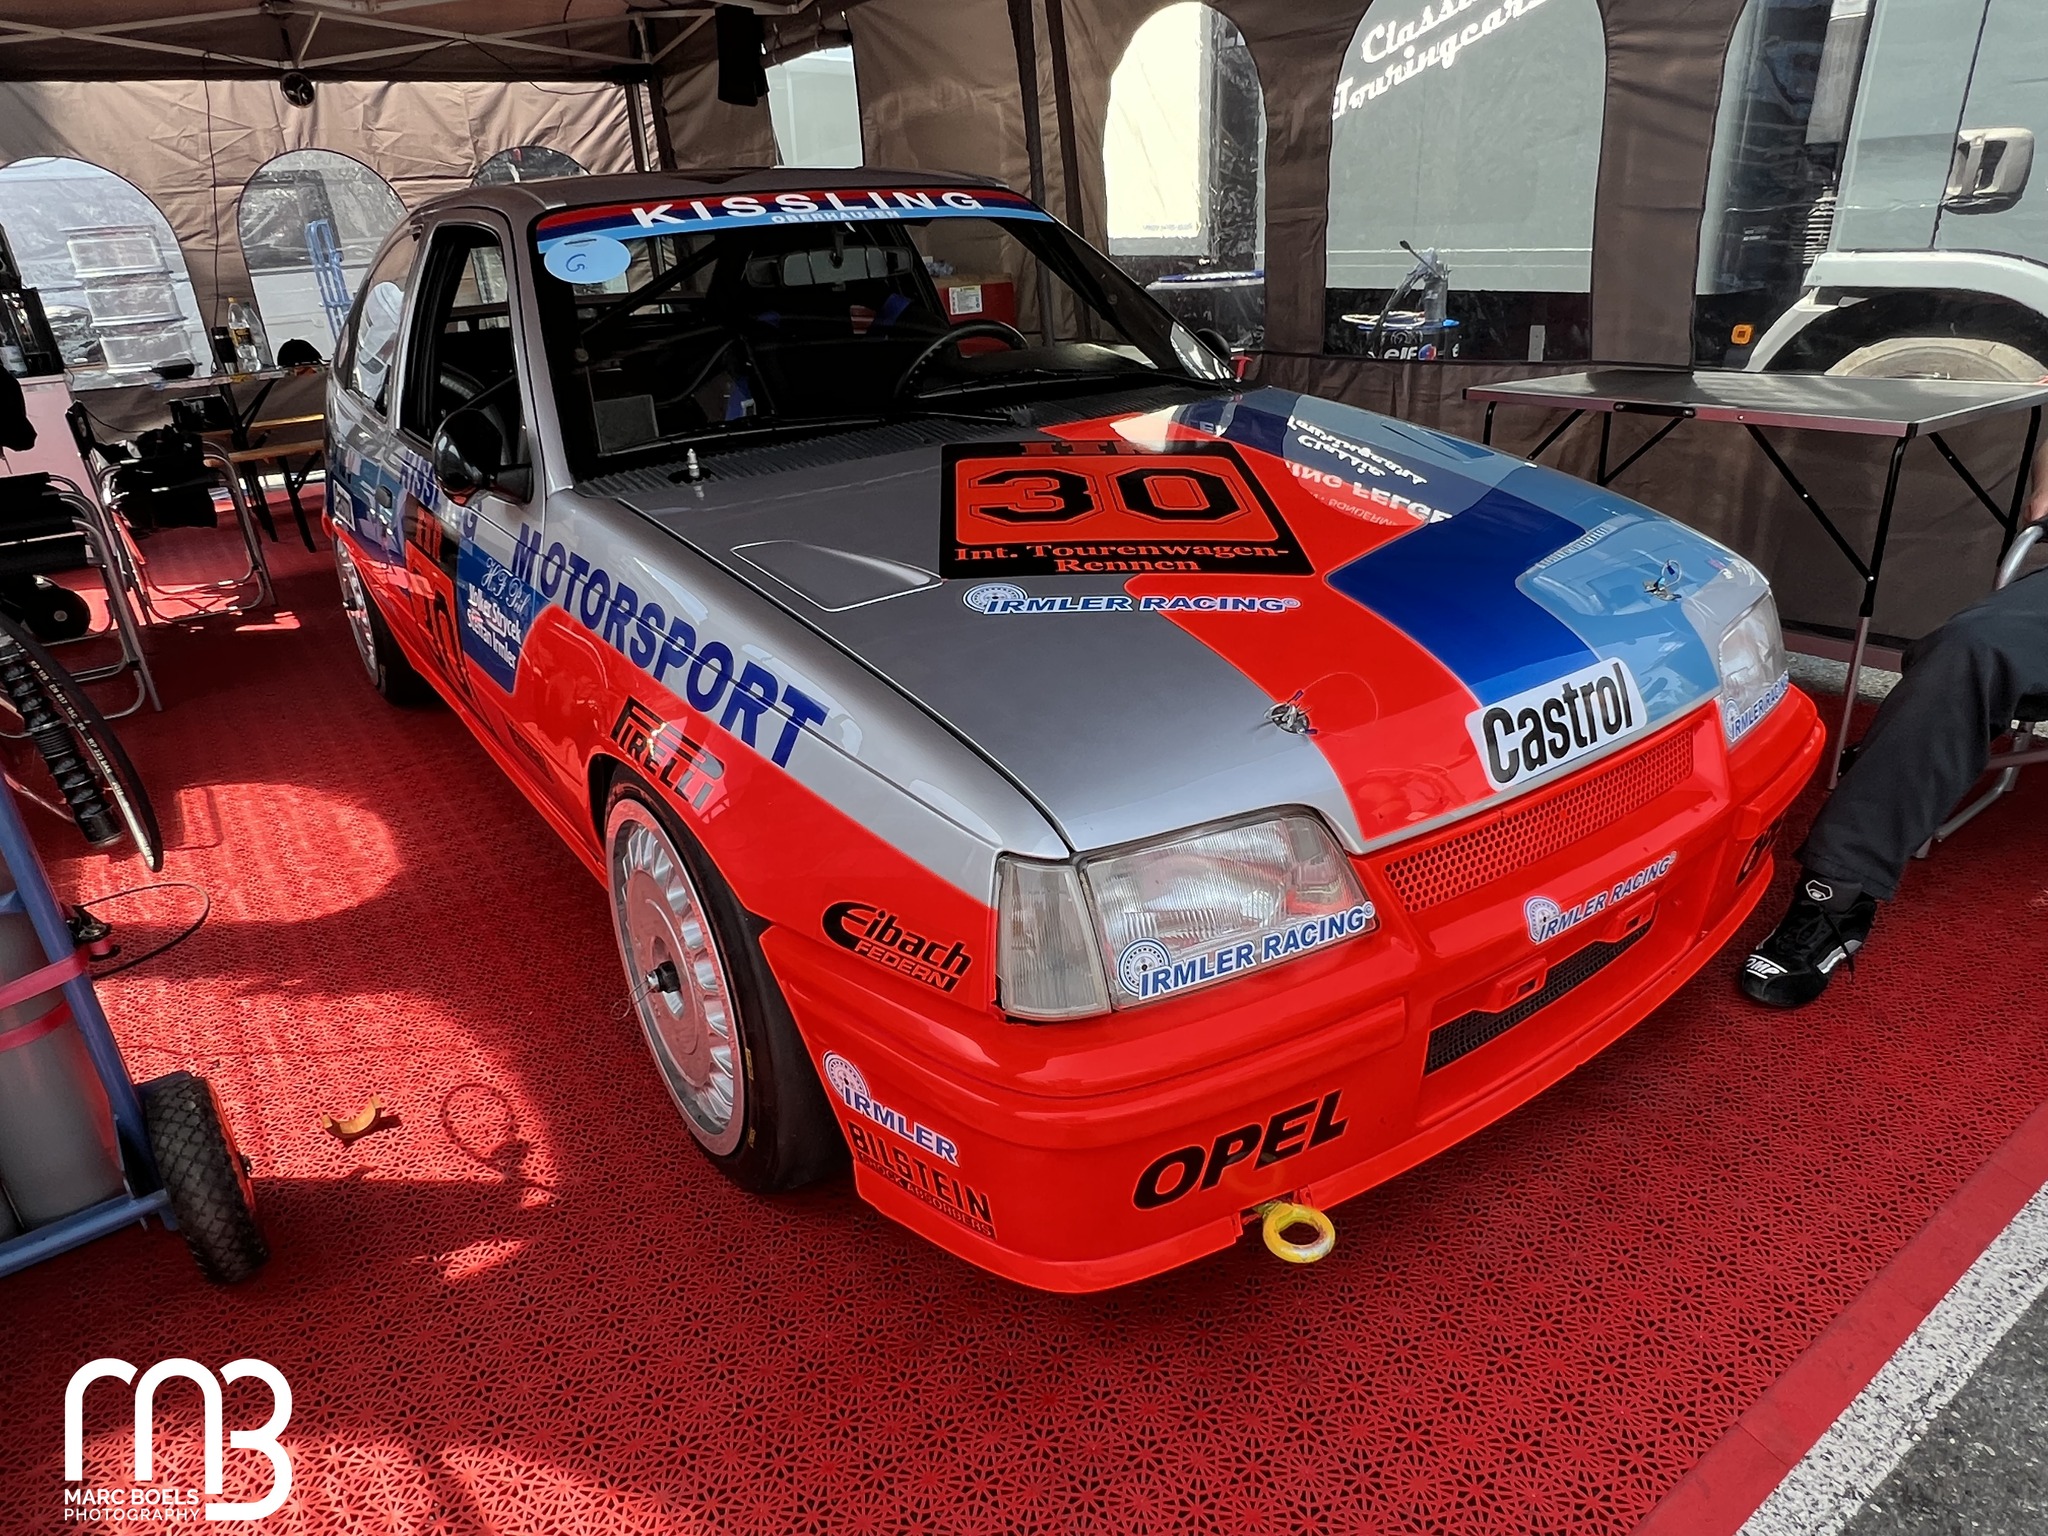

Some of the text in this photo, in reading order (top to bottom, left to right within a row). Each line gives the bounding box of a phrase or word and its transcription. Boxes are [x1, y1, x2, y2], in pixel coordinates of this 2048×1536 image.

[632, 191, 983, 228] KISSLING
[770, 210, 900, 224] OBERHAUSEN
[968, 466, 1252, 527] 30
[954, 545, 1289, 562] Int. Tourenwagen-
[1054, 560, 1201, 572] Rennen
[1140, 597, 1285, 612] RACING
[511, 522, 830, 768] MOTORSPORT
[609, 696, 726, 811] PIRELLI
[1481, 661, 1634, 785] Castrol
[1730, 699, 1767, 740] IRMLER
[1540, 856, 1672, 942] IRMLER RACING
[822, 901, 972, 977] Eibach
[855, 941, 958, 993] FEDERN
[1140, 908, 1364, 998] IRMLER RACING
[844, 1086, 957, 1164] IRMLER
[1132, 1088, 1350, 1211] OPEL
[847, 1121, 991, 1223] BILSTEIN
